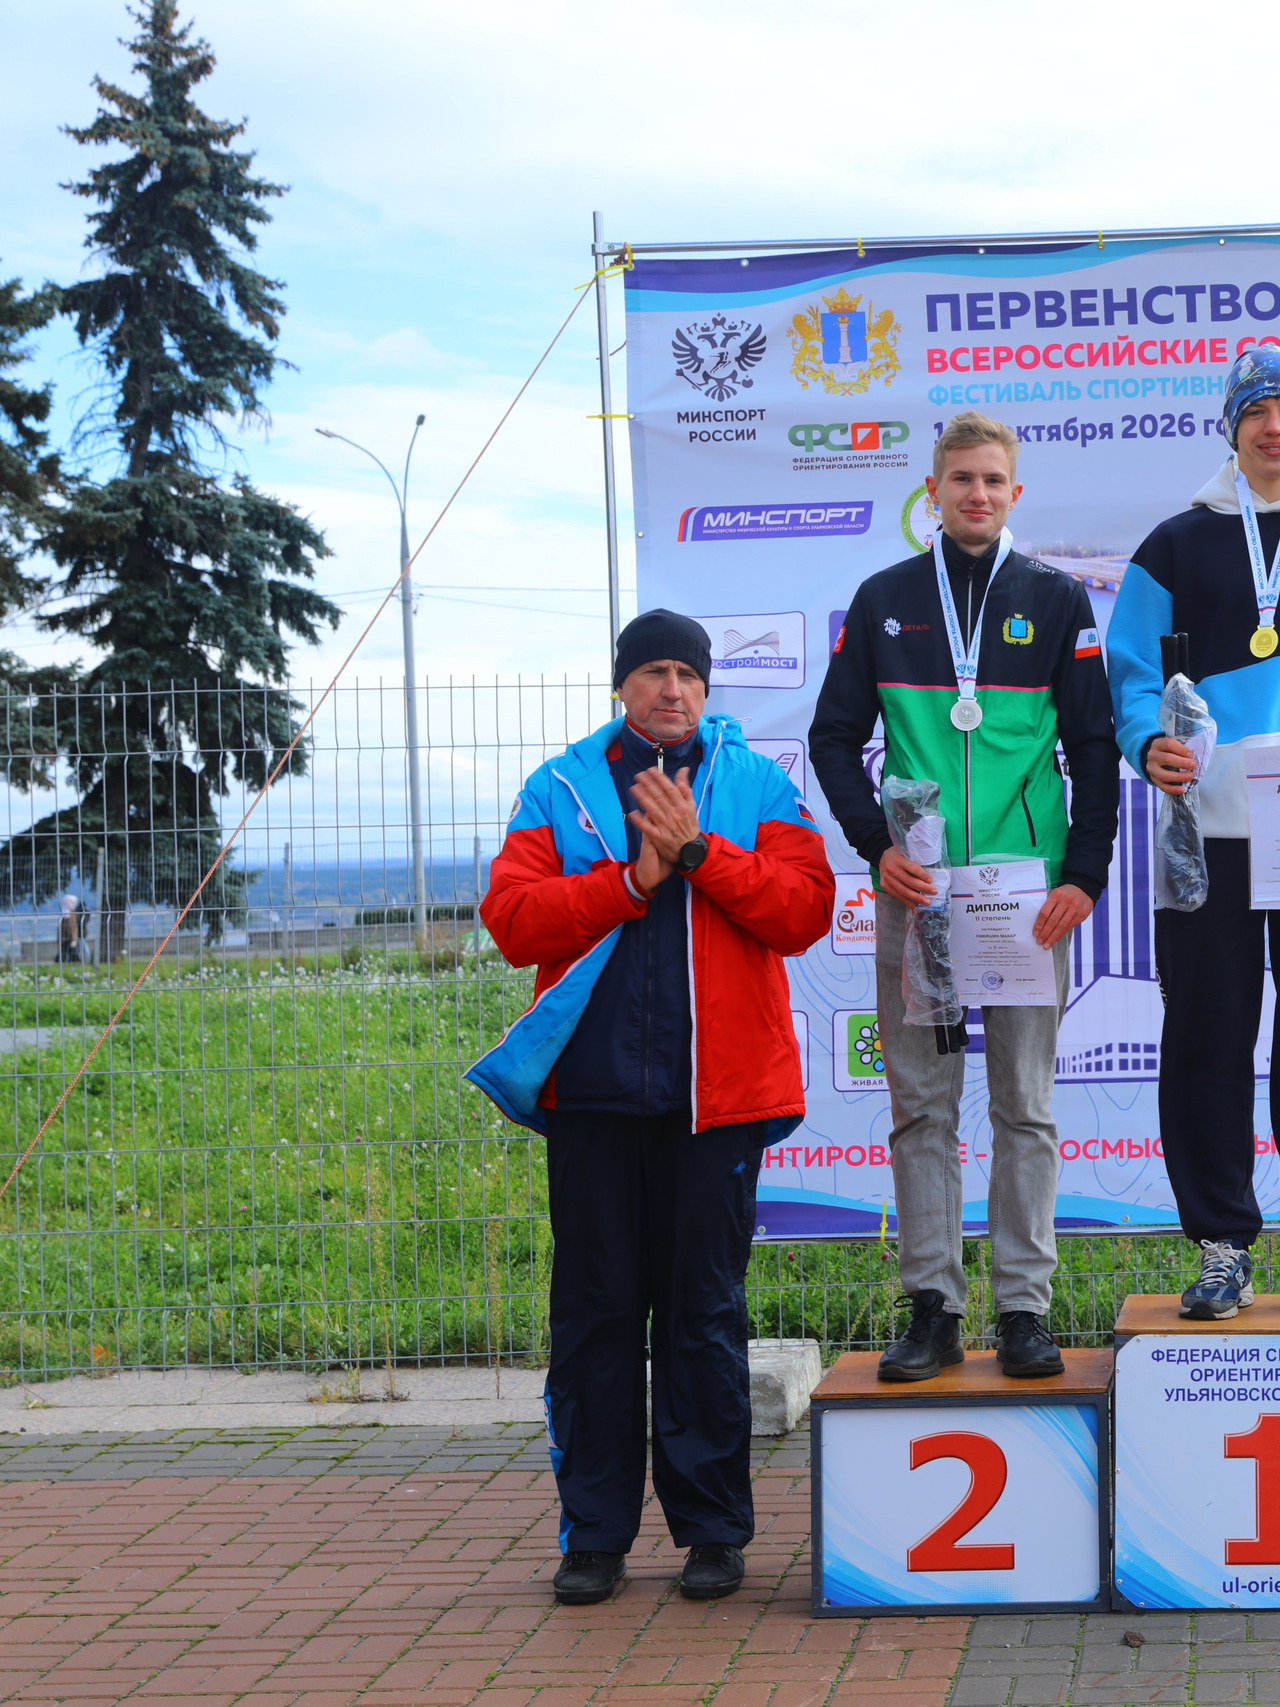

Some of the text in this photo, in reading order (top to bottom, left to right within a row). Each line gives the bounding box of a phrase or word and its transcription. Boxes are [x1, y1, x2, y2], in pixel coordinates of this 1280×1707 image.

[927, 335, 1228, 373] ВСЕРОССИЙСКИЕ
[928, 381, 1081, 406] ФЕСТИВАЛЬ
[677, 409, 766, 424] МИНСПОРТ
[689, 428, 756, 442] РОССИИ
[1016, 417, 1113, 448] ктября
[1121, 413, 1196, 439] 2026
[792, 453, 908, 464] ФЕДЕРАЦИЯ СПОРТИВНОГО
[792, 462, 871, 471] ОРИЕНТИРОВАНИЯ
[703, 507, 865, 527] МИНСПОРТ
[1245, 505, 1257, 546] МИНИСТЕРСТВО
[1253, 545, 1262, 567] СПОРТА
[965, 902, 1020, 913] ДИПЛОМ
[837, 910, 876, 933] Сла
[1151, 1348, 1260, 1364] ФЕДЕРАЦИЯ
[907, 1430, 1015, 1572] 2
